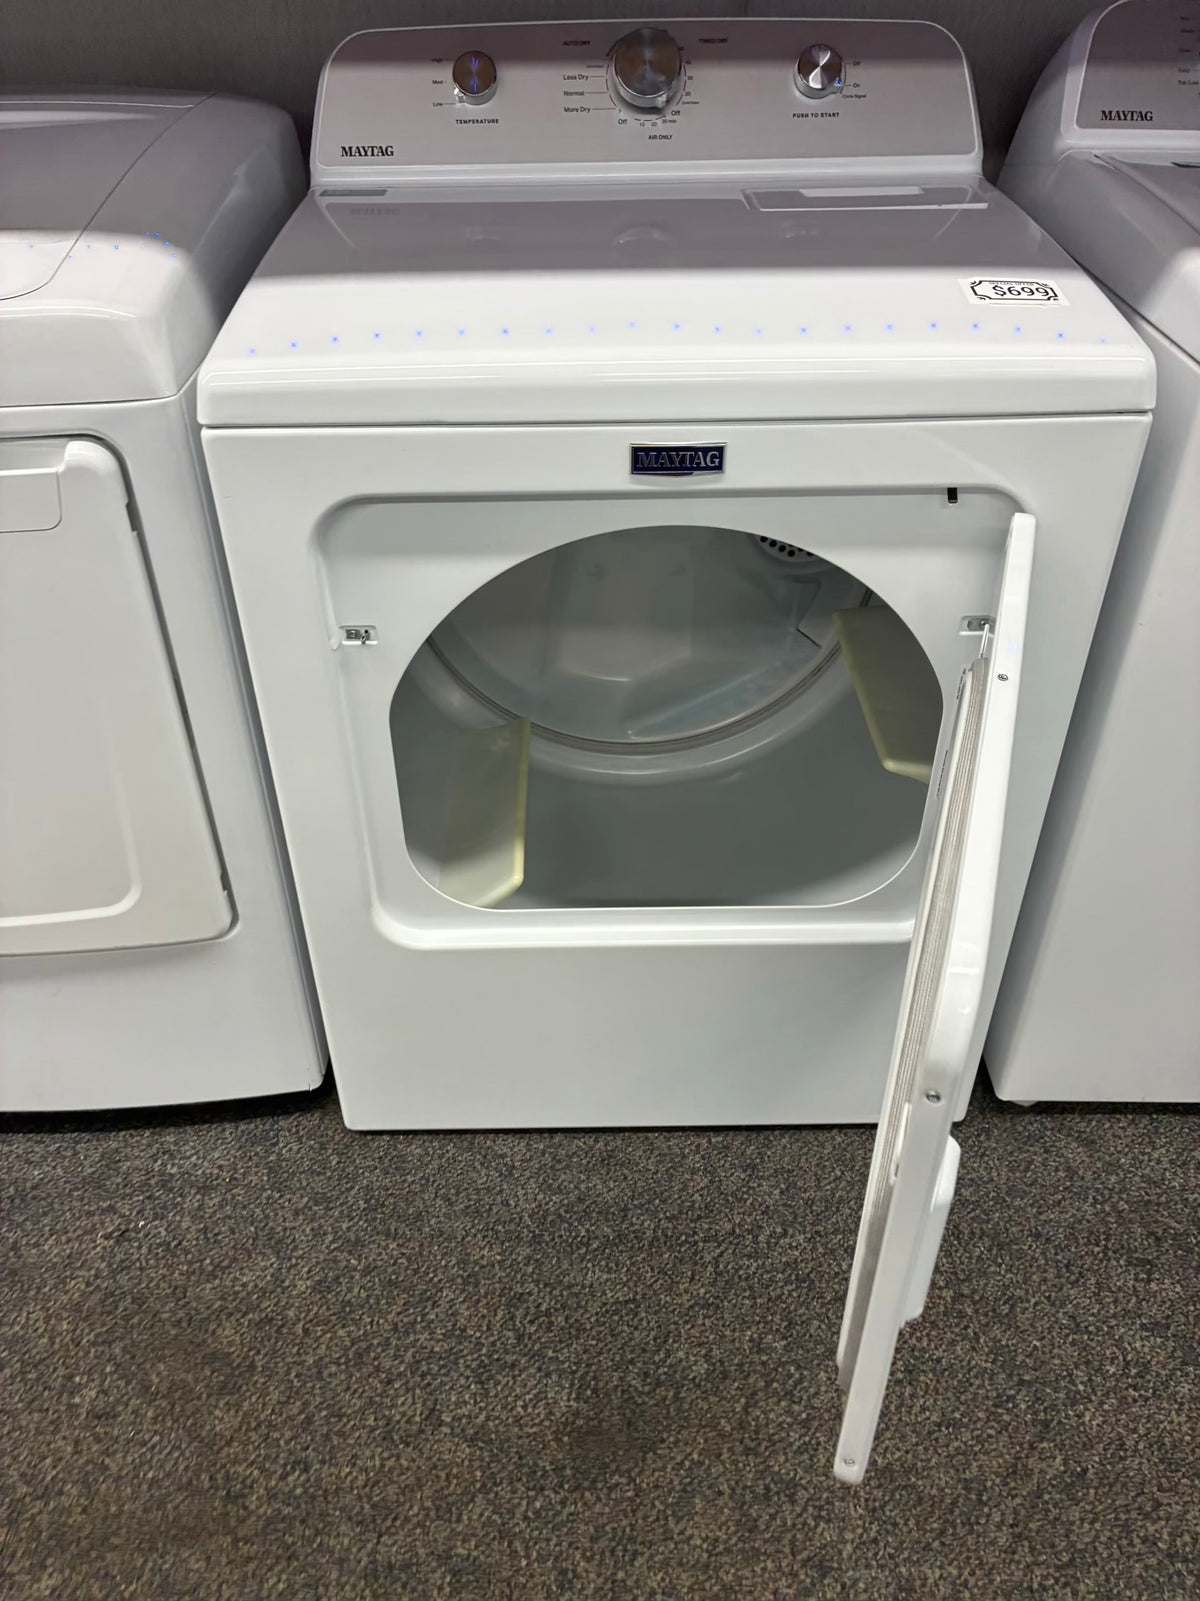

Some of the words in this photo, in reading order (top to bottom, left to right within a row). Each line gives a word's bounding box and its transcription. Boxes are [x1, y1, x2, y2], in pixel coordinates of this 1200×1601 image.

[578, 73, 589, 81] Dry
[1100, 110, 1154, 122] MAYTAG
[340, 145, 395, 158] MAYTAG
[992, 285, 1049, 296] $699
[636, 451, 721, 468] MAYTAG
